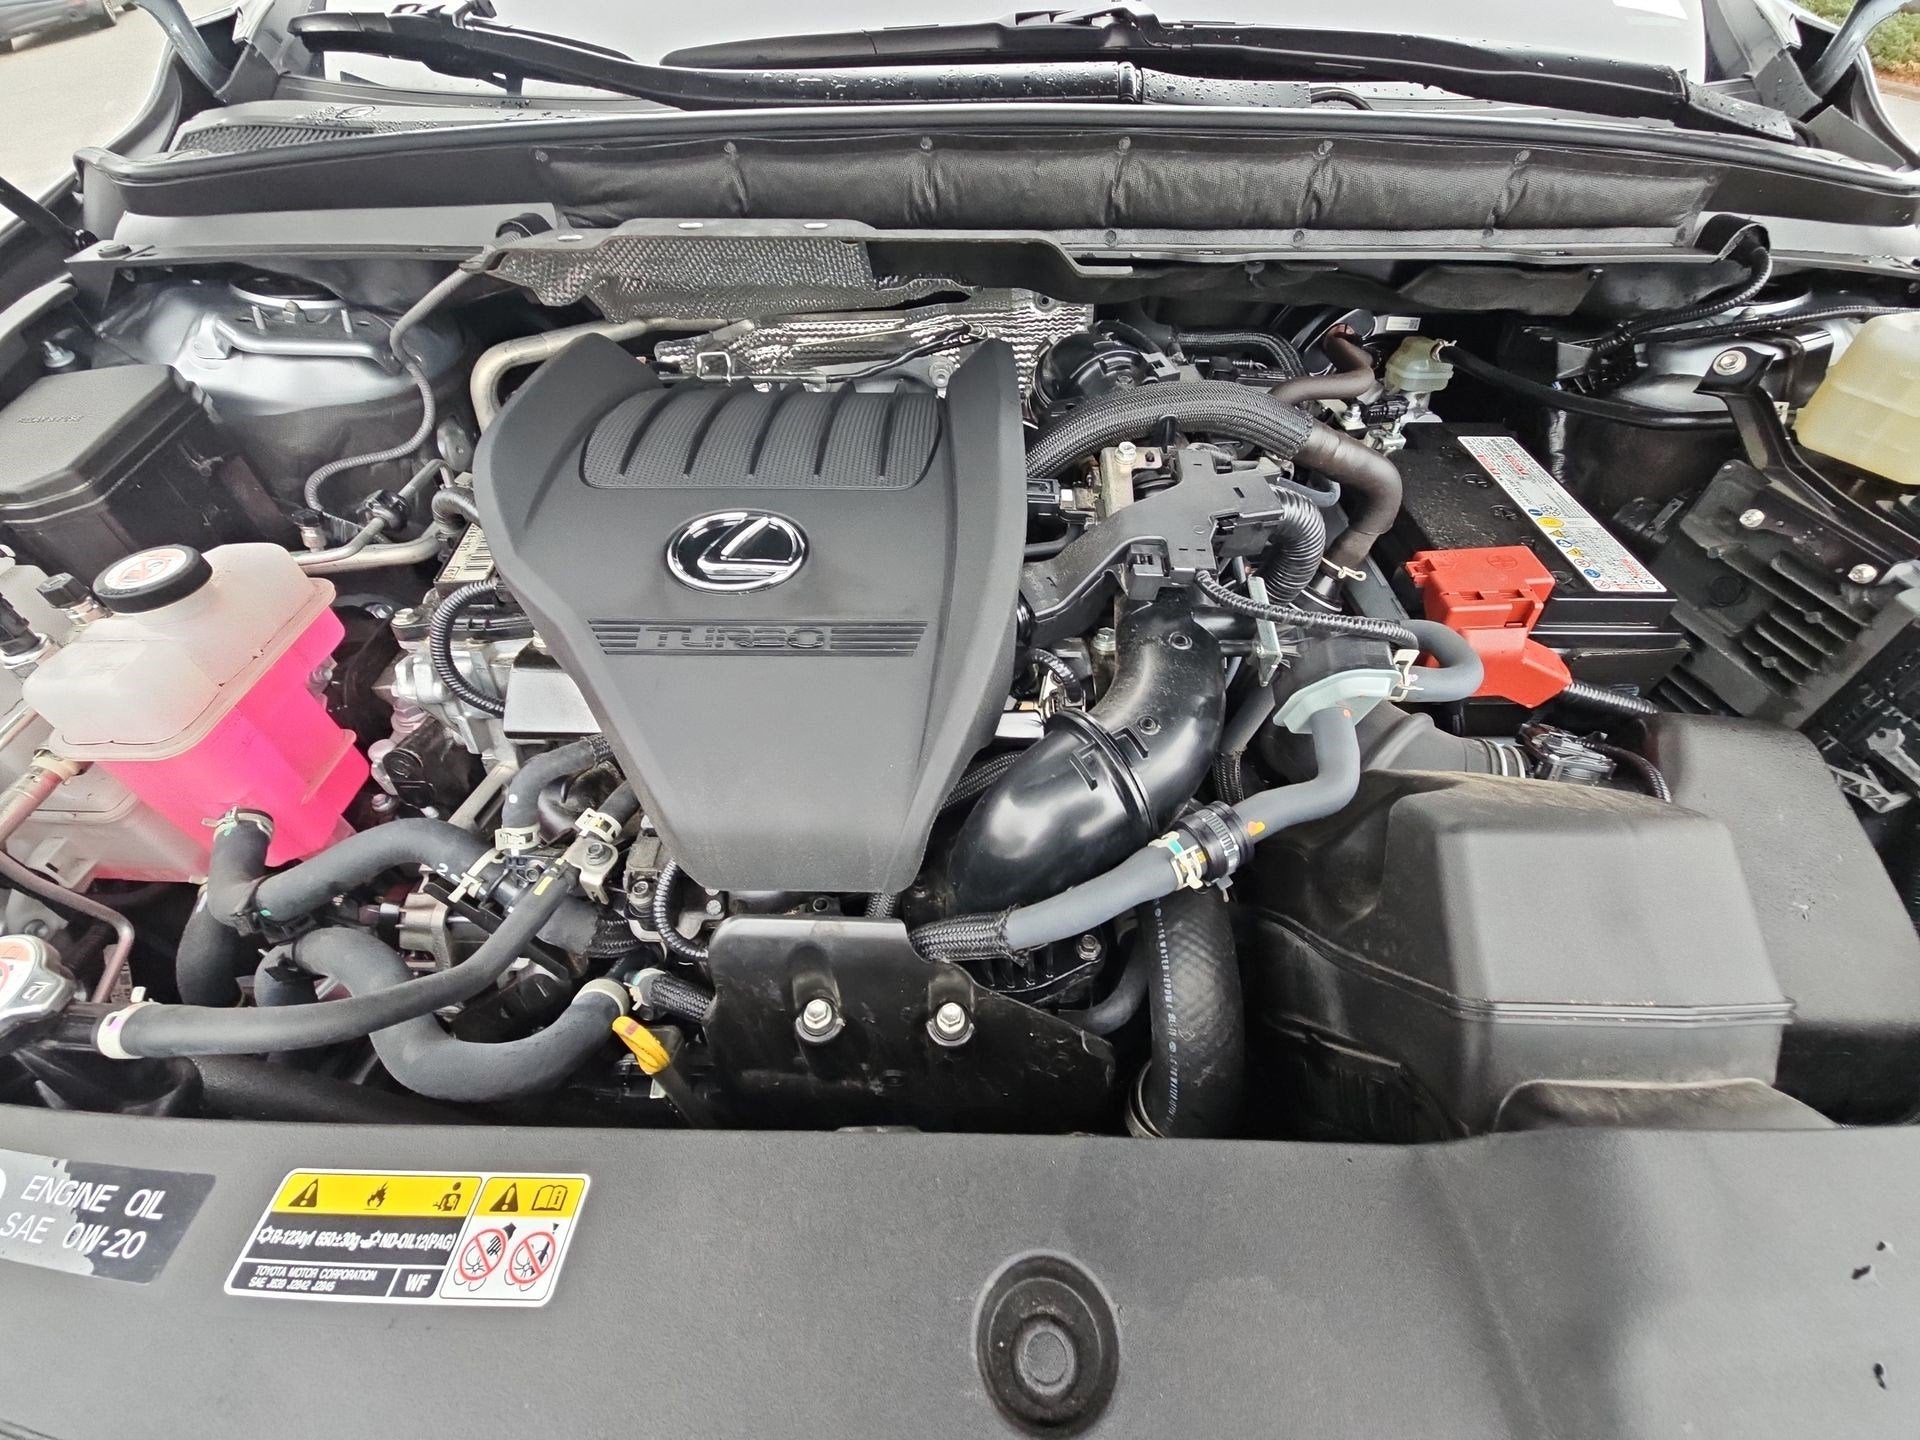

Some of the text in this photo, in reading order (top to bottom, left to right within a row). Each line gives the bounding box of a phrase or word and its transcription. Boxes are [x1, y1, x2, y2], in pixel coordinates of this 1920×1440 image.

[645, 625, 825, 649] TURBO
[20, 1175, 166, 1220] ENGINE OIL
[0, 1211, 56, 1244] SAE
[248, 1277, 268, 1288] SAE
[255, 1265, 378, 1281] TOYOTA MOTOR CORPORATION
[404, 1273, 431, 1292] WF
